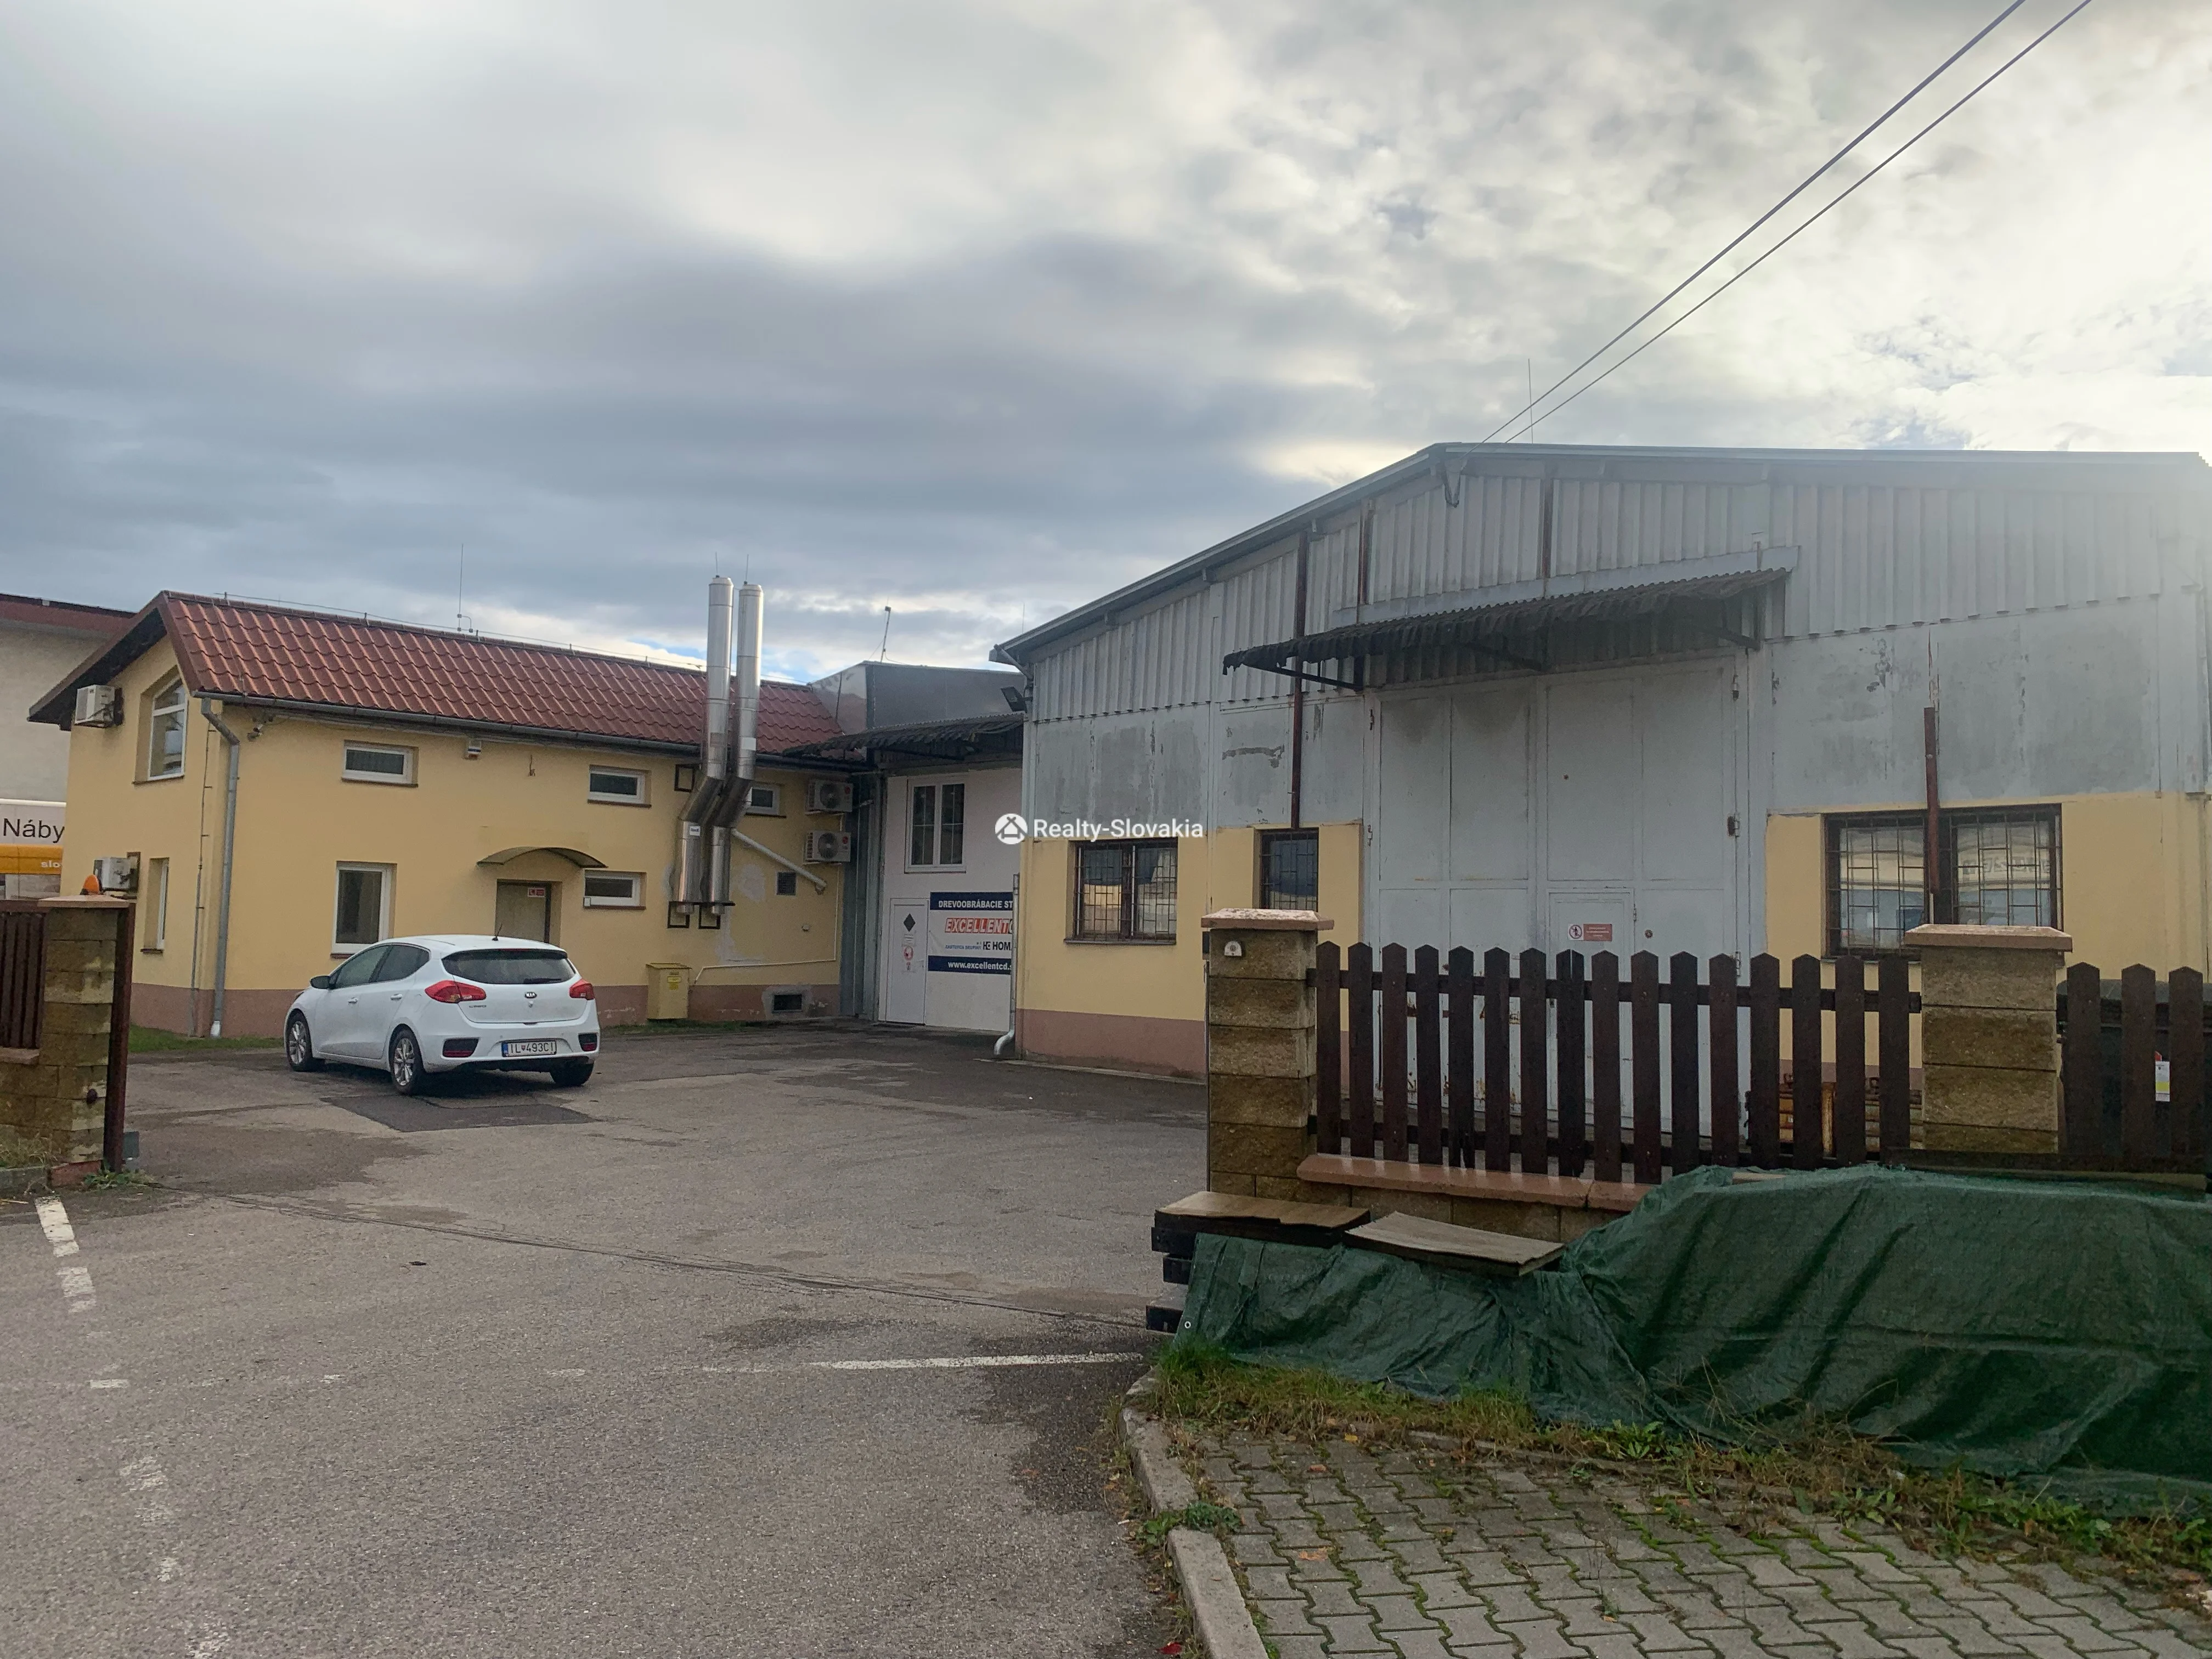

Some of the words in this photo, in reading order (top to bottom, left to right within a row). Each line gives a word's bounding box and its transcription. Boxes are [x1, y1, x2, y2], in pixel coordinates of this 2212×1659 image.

[3, 818, 65, 843] Náby
[938, 899, 1002, 909] DREVOOBRÁBACIE
[992, 941, 1012, 951] HOM
